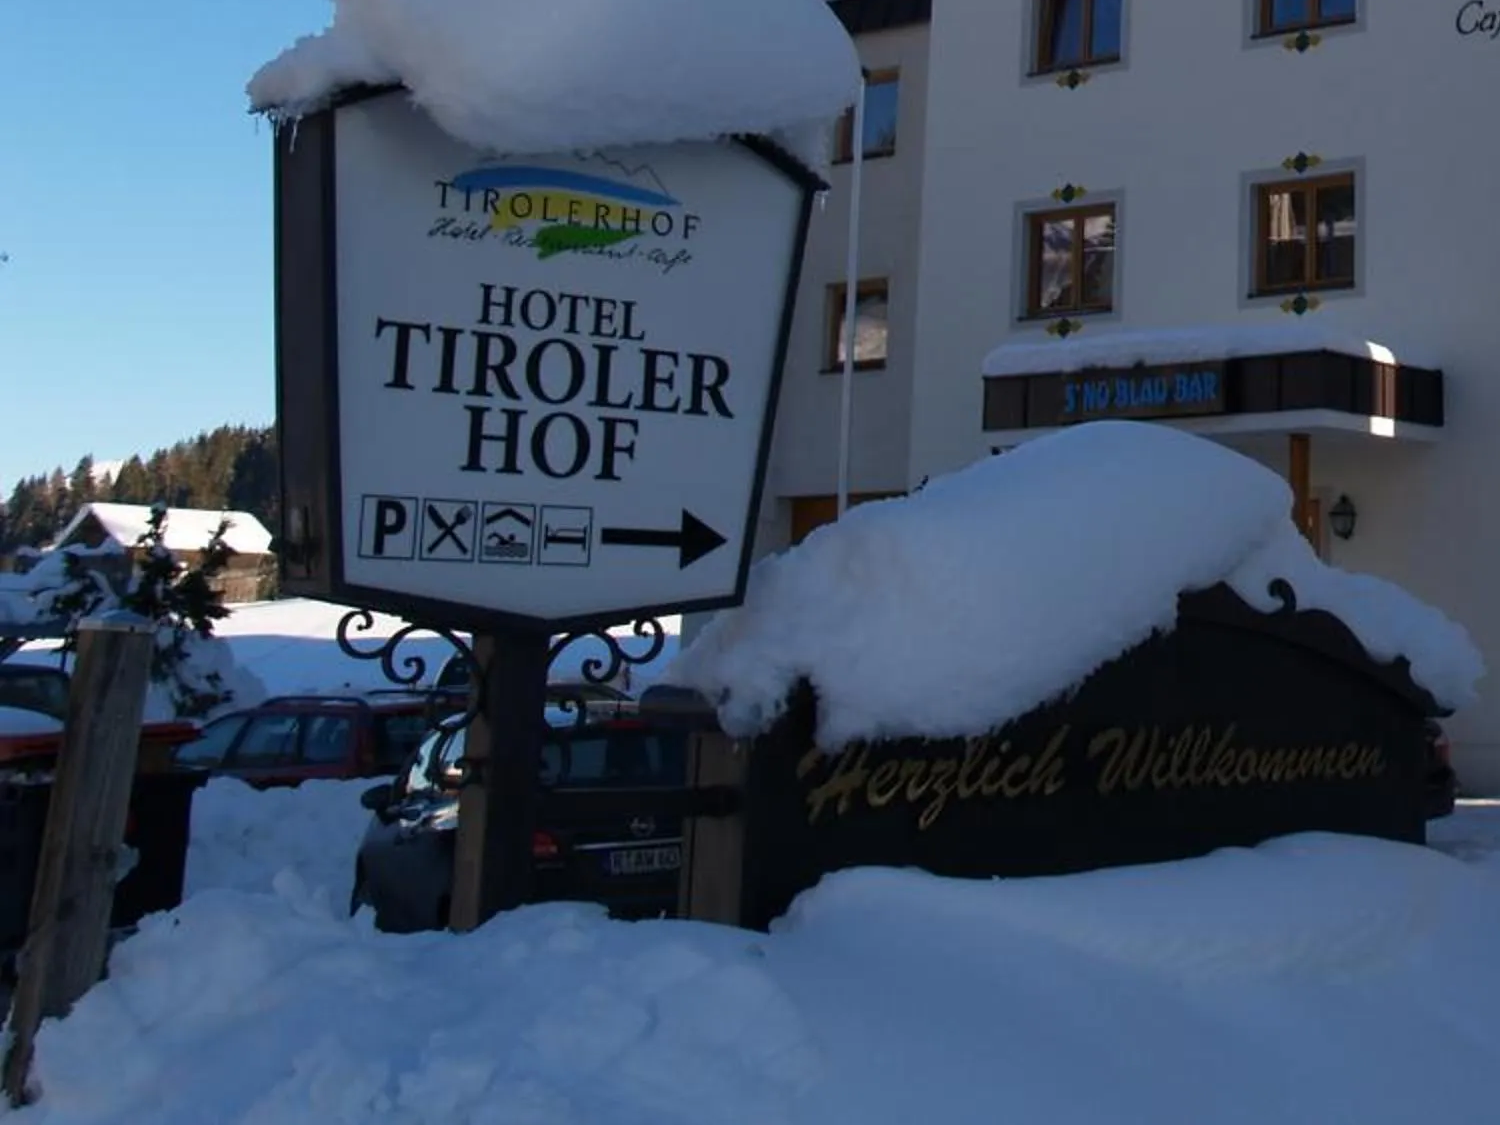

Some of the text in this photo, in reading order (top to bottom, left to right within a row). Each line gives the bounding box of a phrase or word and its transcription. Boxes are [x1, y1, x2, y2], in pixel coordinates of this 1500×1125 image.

[434, 181, 701, 239] TIROLERHOF
[477, 283, 645, 341] HOTEL
[375, 318, 734, 419] TIROLER
[1174, 371, 1217, 403] BAR
[460, 404, 639, 481] HOF
[796, 721, 1386, 830] Herzlich Willkommen
